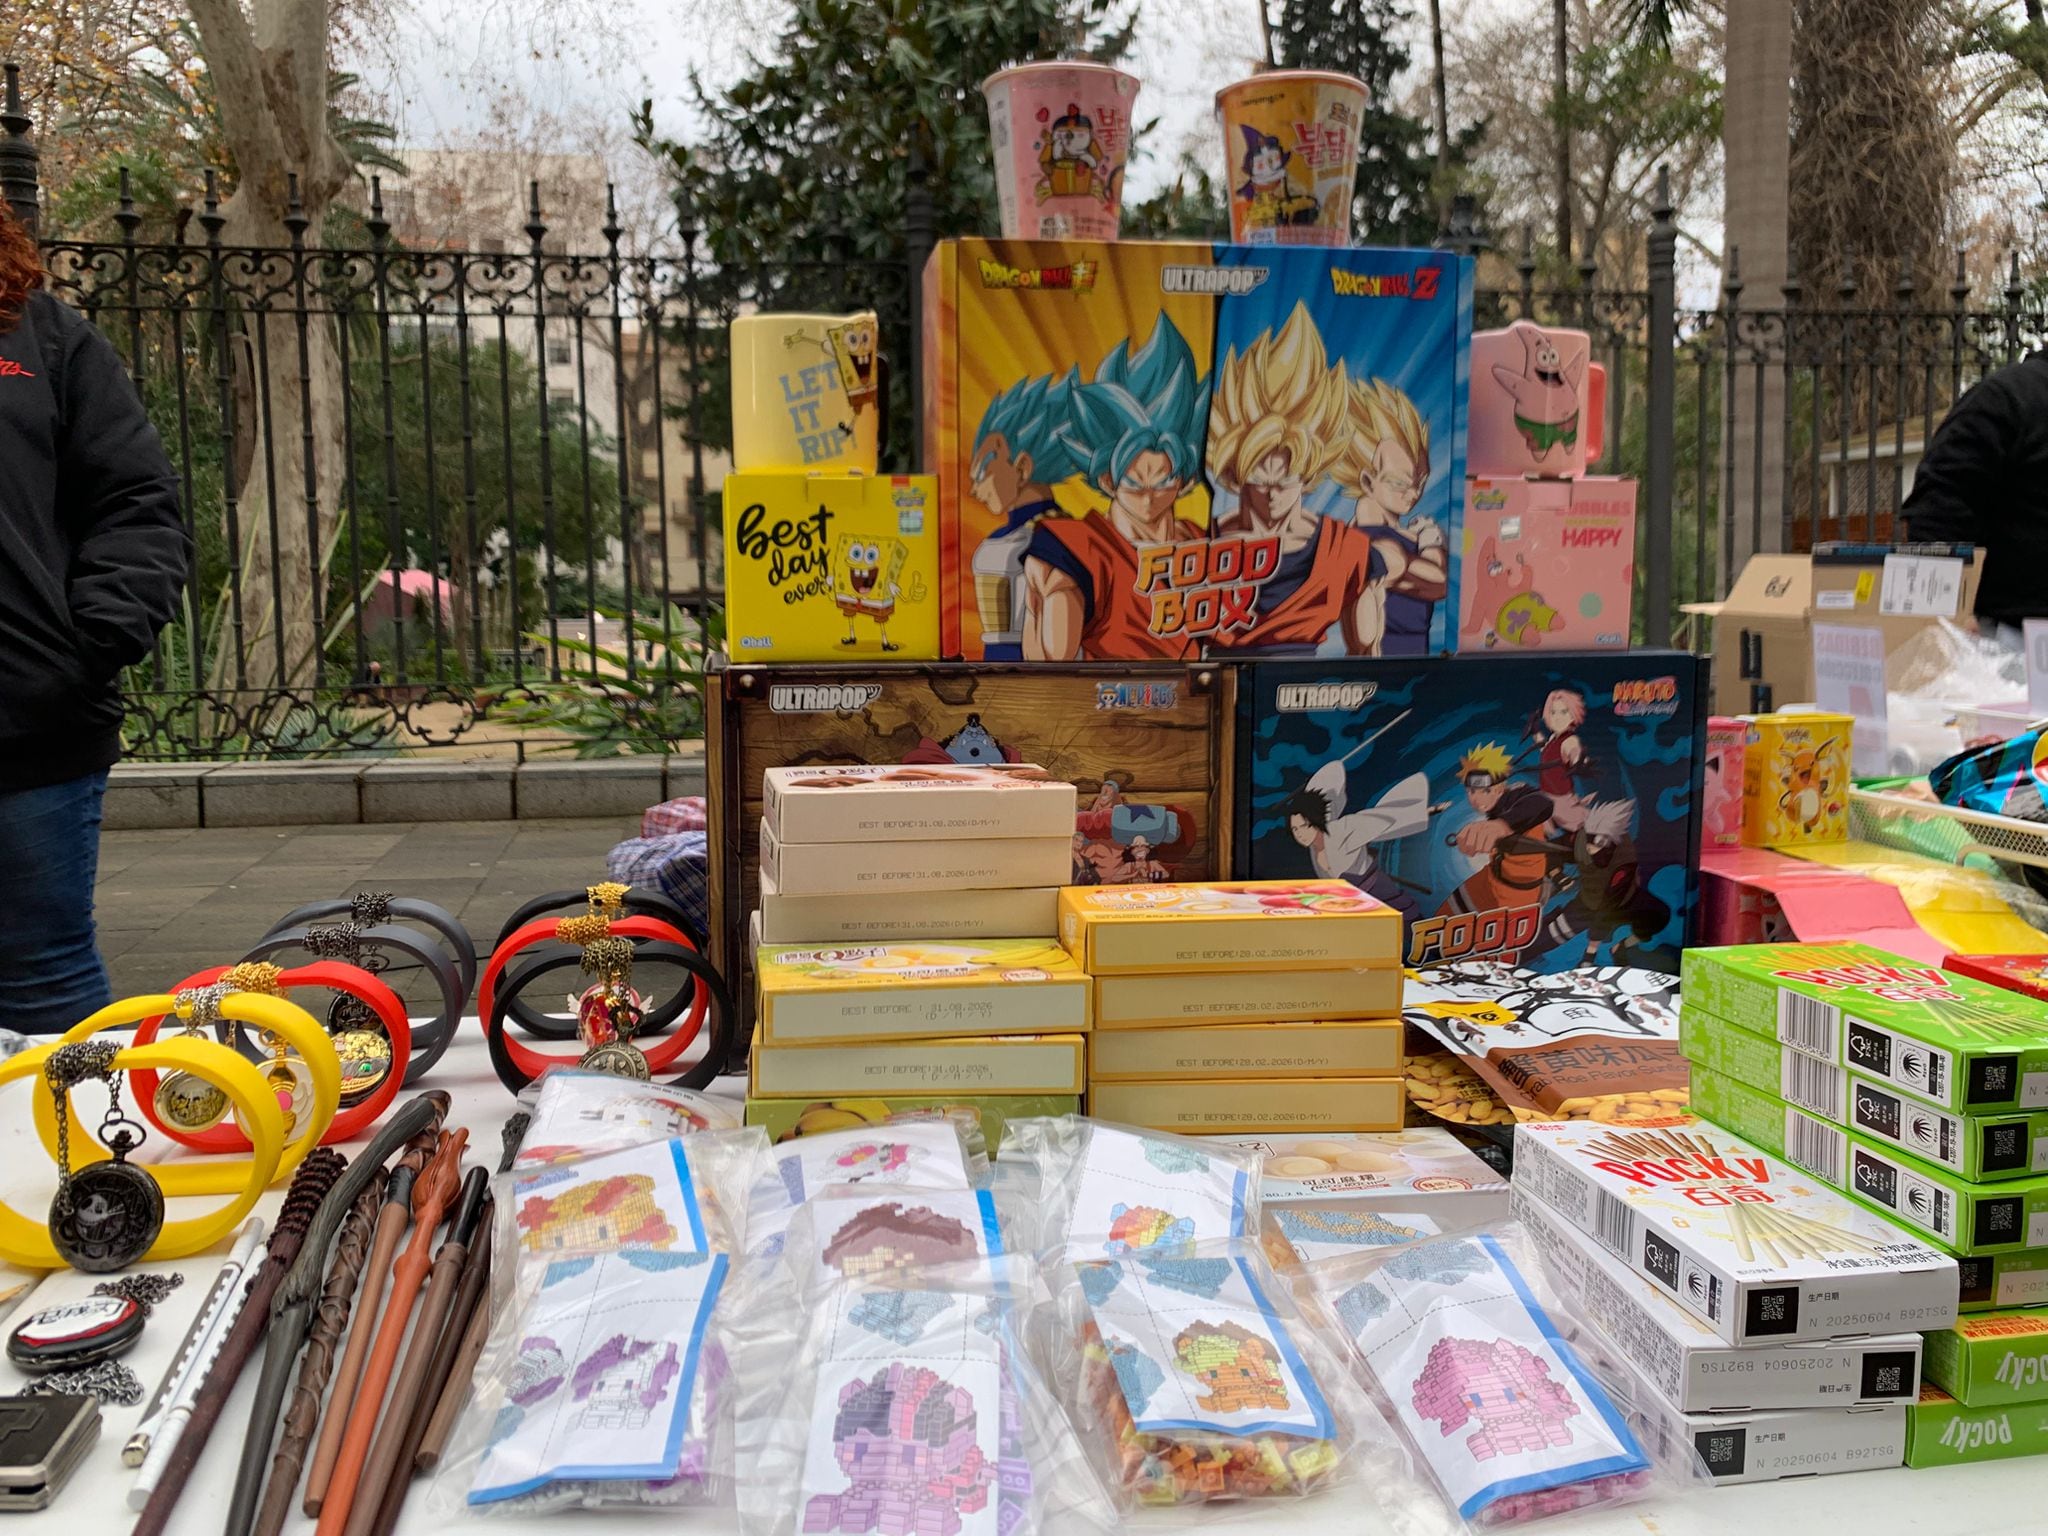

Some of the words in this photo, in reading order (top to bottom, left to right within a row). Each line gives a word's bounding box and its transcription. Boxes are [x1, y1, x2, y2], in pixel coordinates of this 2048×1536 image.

[1163, 267, 1256, 293] ULTRAPOP
[1331, 267, 1380, 296] DRAGON
[1411, 267, 1442, 299] Z
[779, 360, 840, 404] LET
[789, 402, 821, 433] IT
[737, 503, 834, 560] best
[1561, 527, 1624, 549] HAPPY
[768, 548, 830, 587] day
[1135, 536, 1281, 595] FOOD
[1149, 584, 1257, 638] BOX
[772, 685, 866, 712] ULTRAPOP
[1278, 685, 1365, 711] ULTRAPOP
[1613, 680, 1675, 703] NARUTO
[858, 820, 879, 829] BEST
[856, 872, 877, 881] BEST
[1408, 903, 1545, 968] FOOD
[1176, 950, 1197, 959] BEST
[841, 1006, 867, 1017] BEST
[1183, 1004, 1203, 1013] BEST
[1176, 1058, 1197, 1067] BEST
[864, 1065, 887, 1075] BEST
[1555, 1071, 1588, 1085] Roe
[1588, 1069, 1637, 1082] Flavor
[2029, 1086, 2037, 1096] N
[1177, 1112, 1198, 1121] BEST
[2039, 1152, 2046, 1161] N
[2036, 1228, 2045, 1237] N
[2006, 1284, 2014, 1293] N
[1808, 1291, 1840, 1303] 生产日期
[1809, 1318, 1818, 1328] N
[1826, 1312, 1891, 1327] 20250604
[1899, 1305, 1949, 1321] B92TSG
[1701, 1360, 1754, 1373] B92TSG
[1764, 1357, 1833, 1371] 20250604
[1842, 1357, 1851, 1368] N
[1819, 1384, 1852, 1393] 生产日期
[1754, 1432, 1786, 1444] 生产日期
[1939, 1414, 2013, 1453] Pocky
[1756, 1459, 1765, 1469] N
[1773, 1452, 1837, 1468] 20250604
[1846, 1446, 1894, 1460] B92TSG
